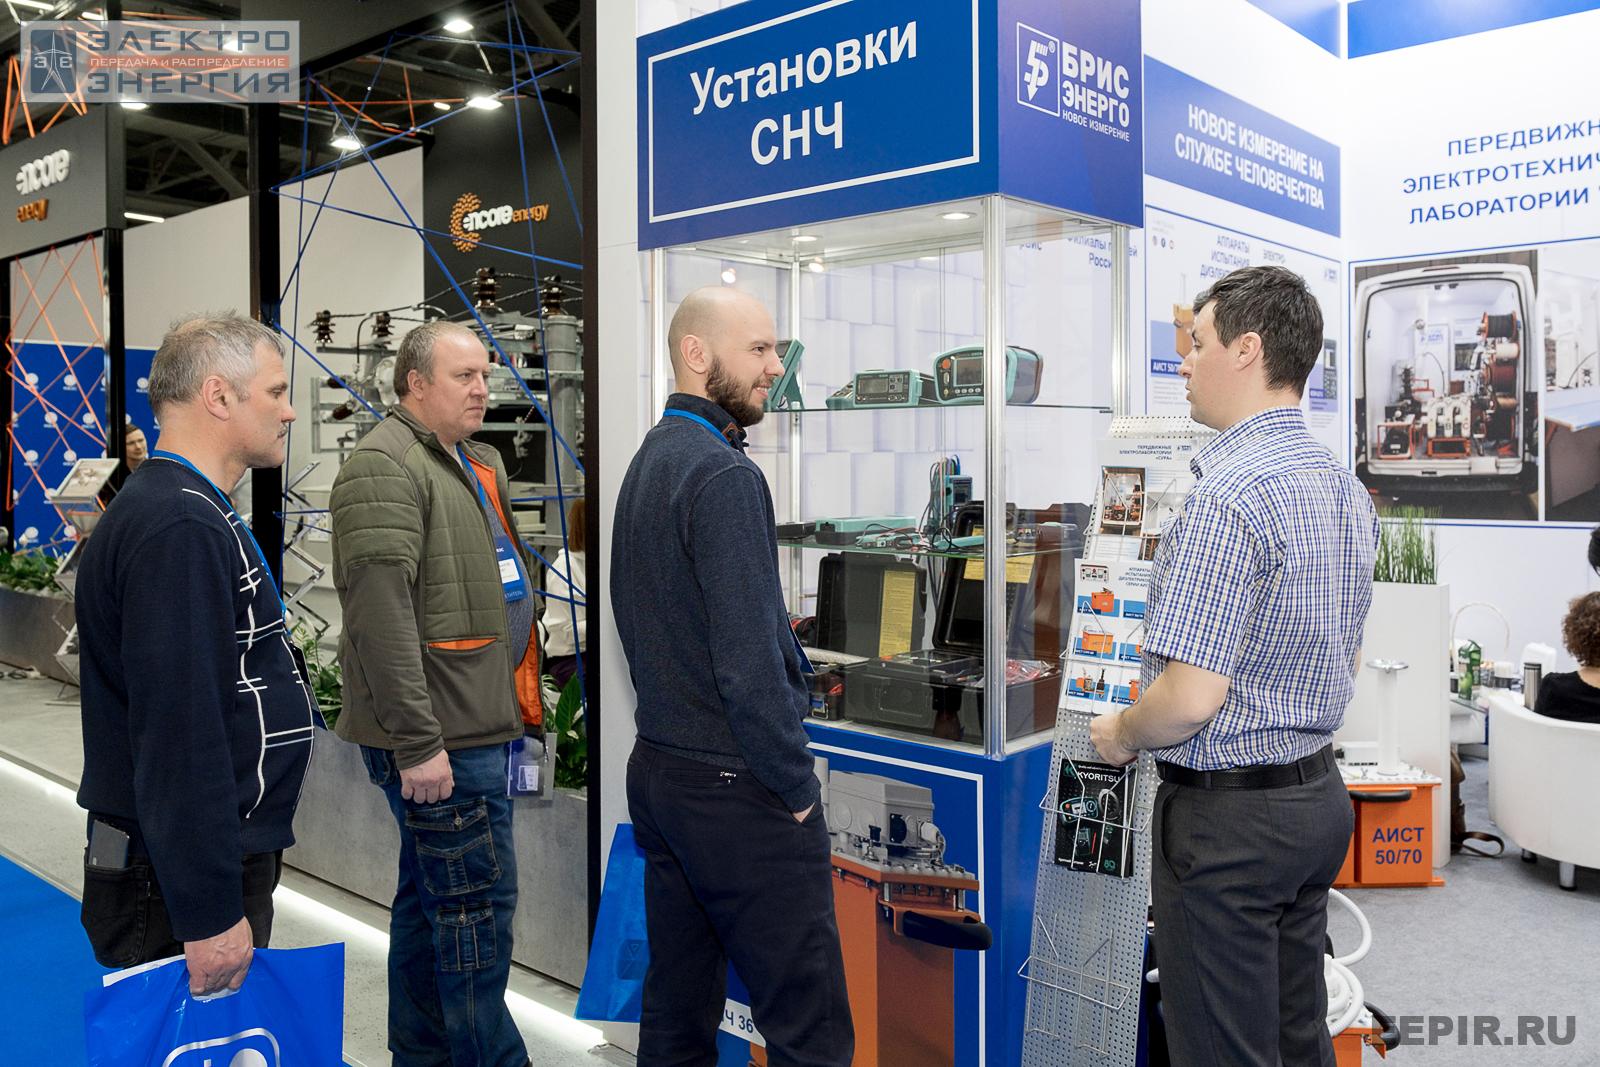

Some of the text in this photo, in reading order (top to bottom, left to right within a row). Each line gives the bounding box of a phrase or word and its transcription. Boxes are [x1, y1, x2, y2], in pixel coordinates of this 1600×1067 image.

[690, 21, 917, 115] Установки
[1062, 41, 1130, 99] БРИС
[1062, 80, 1130, 127] ЭНЕРГО
[751, 101, 843, 165] СНЧ
[1062, 109, 1131, 142] НОВОЕ ИЗМЕРЕНИЕ
[1188, 104, 1325, 183] НОВОЕ ИЗМЕРЕНИЕ НА
[1175, 133, 1325, 210] СЛУЖБЕ ЧЕЛОВЕЧЕСТВА
[462, 204, 550, 231] encore energy
[1409, 187, 1589, 224] ЛАБОРАТОРИИ
[1088, 252, 1112, 269] Росси
[1077, 771, 1120, 783] KYORITSU
[1372, 827, 1424, 843] АИСТ
[1375, 849, 1422, 864] 50/70
